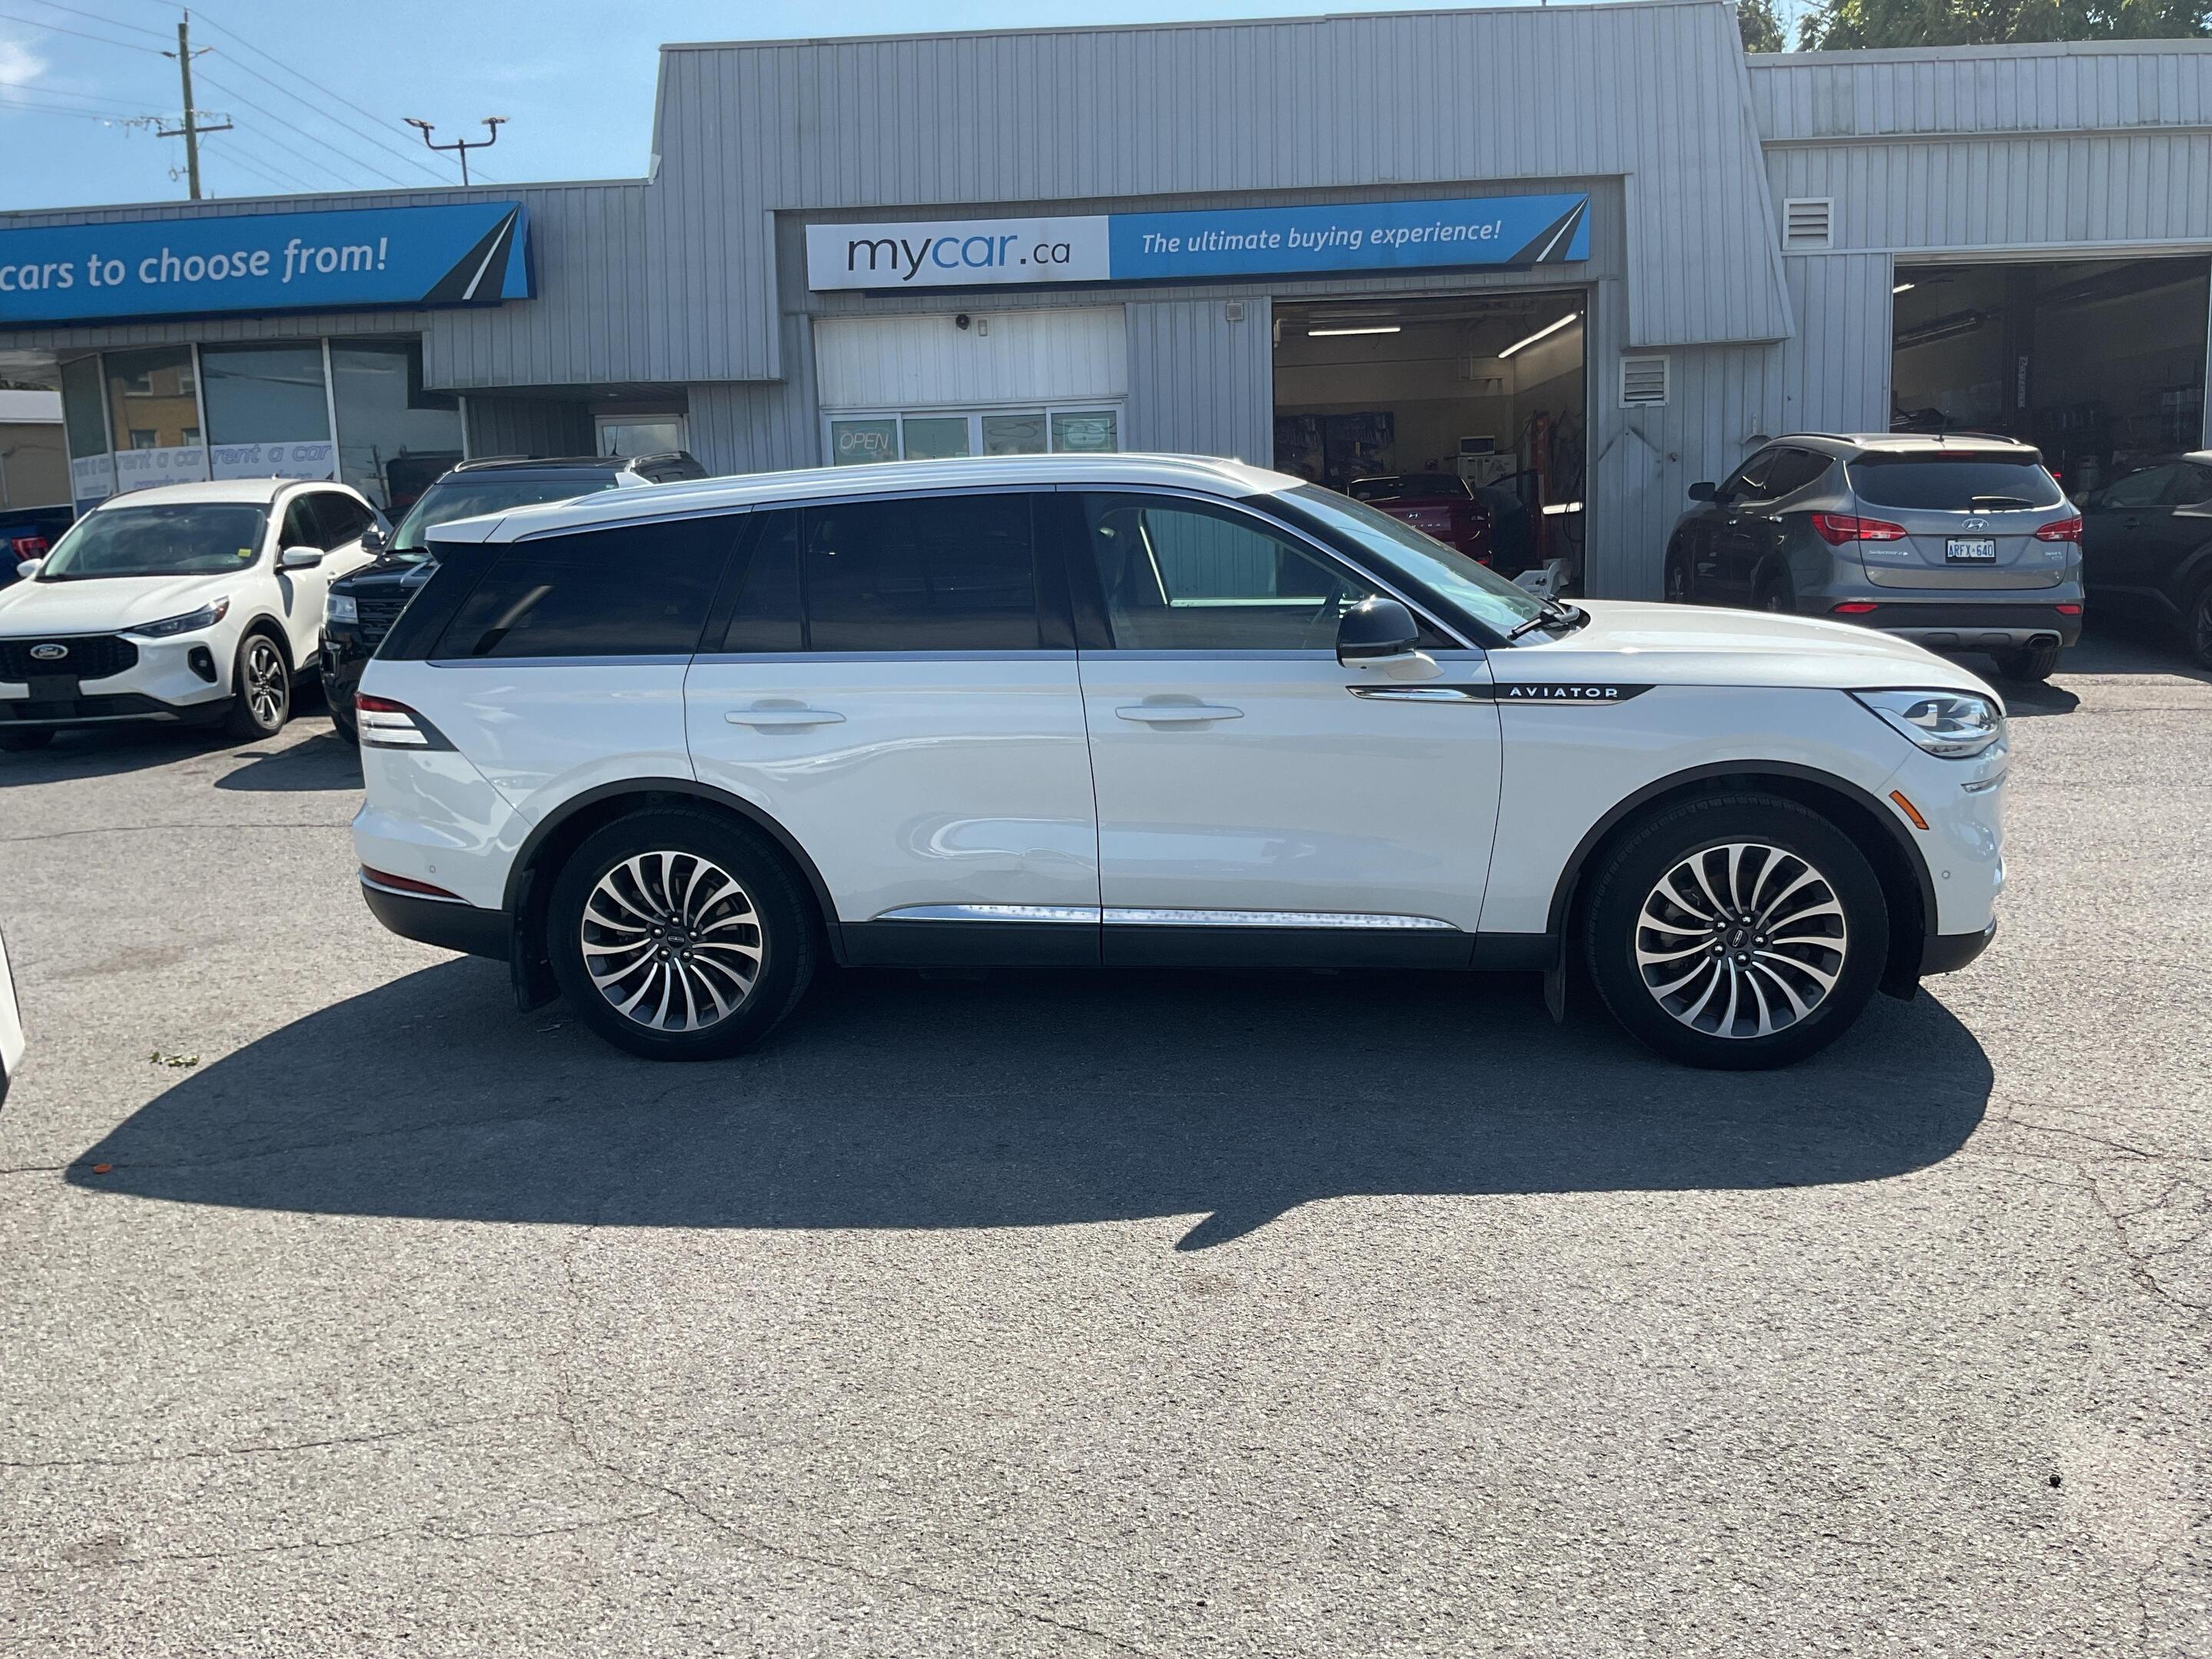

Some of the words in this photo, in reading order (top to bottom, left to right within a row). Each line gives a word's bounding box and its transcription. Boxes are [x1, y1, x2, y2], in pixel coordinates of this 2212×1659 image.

[1142, 233, 1181, 253] The
[1187, 230, 1280, 252] ultimate
[1288, 226, 1363, 252] buying
[1370, 220, 1502, 248] experience!
[0, 263, 74, 291] cars
[87, 253, 126, 286] to
[138, 247, 270, 283] choose
[282, 237, 388, 283] from!
[848, 235, 1071, 281] mycar.ca
[840, 432, 889, 449] OPEN
[157, 452, 169, 469] a
[212, 444, 262, 465] rent
[269, 447, 284, 462] a
[292, 445, 332, 462] car
[1976, 545, 1993, 556] 640
[1509, 687, 1618, 698] AVIATOR
